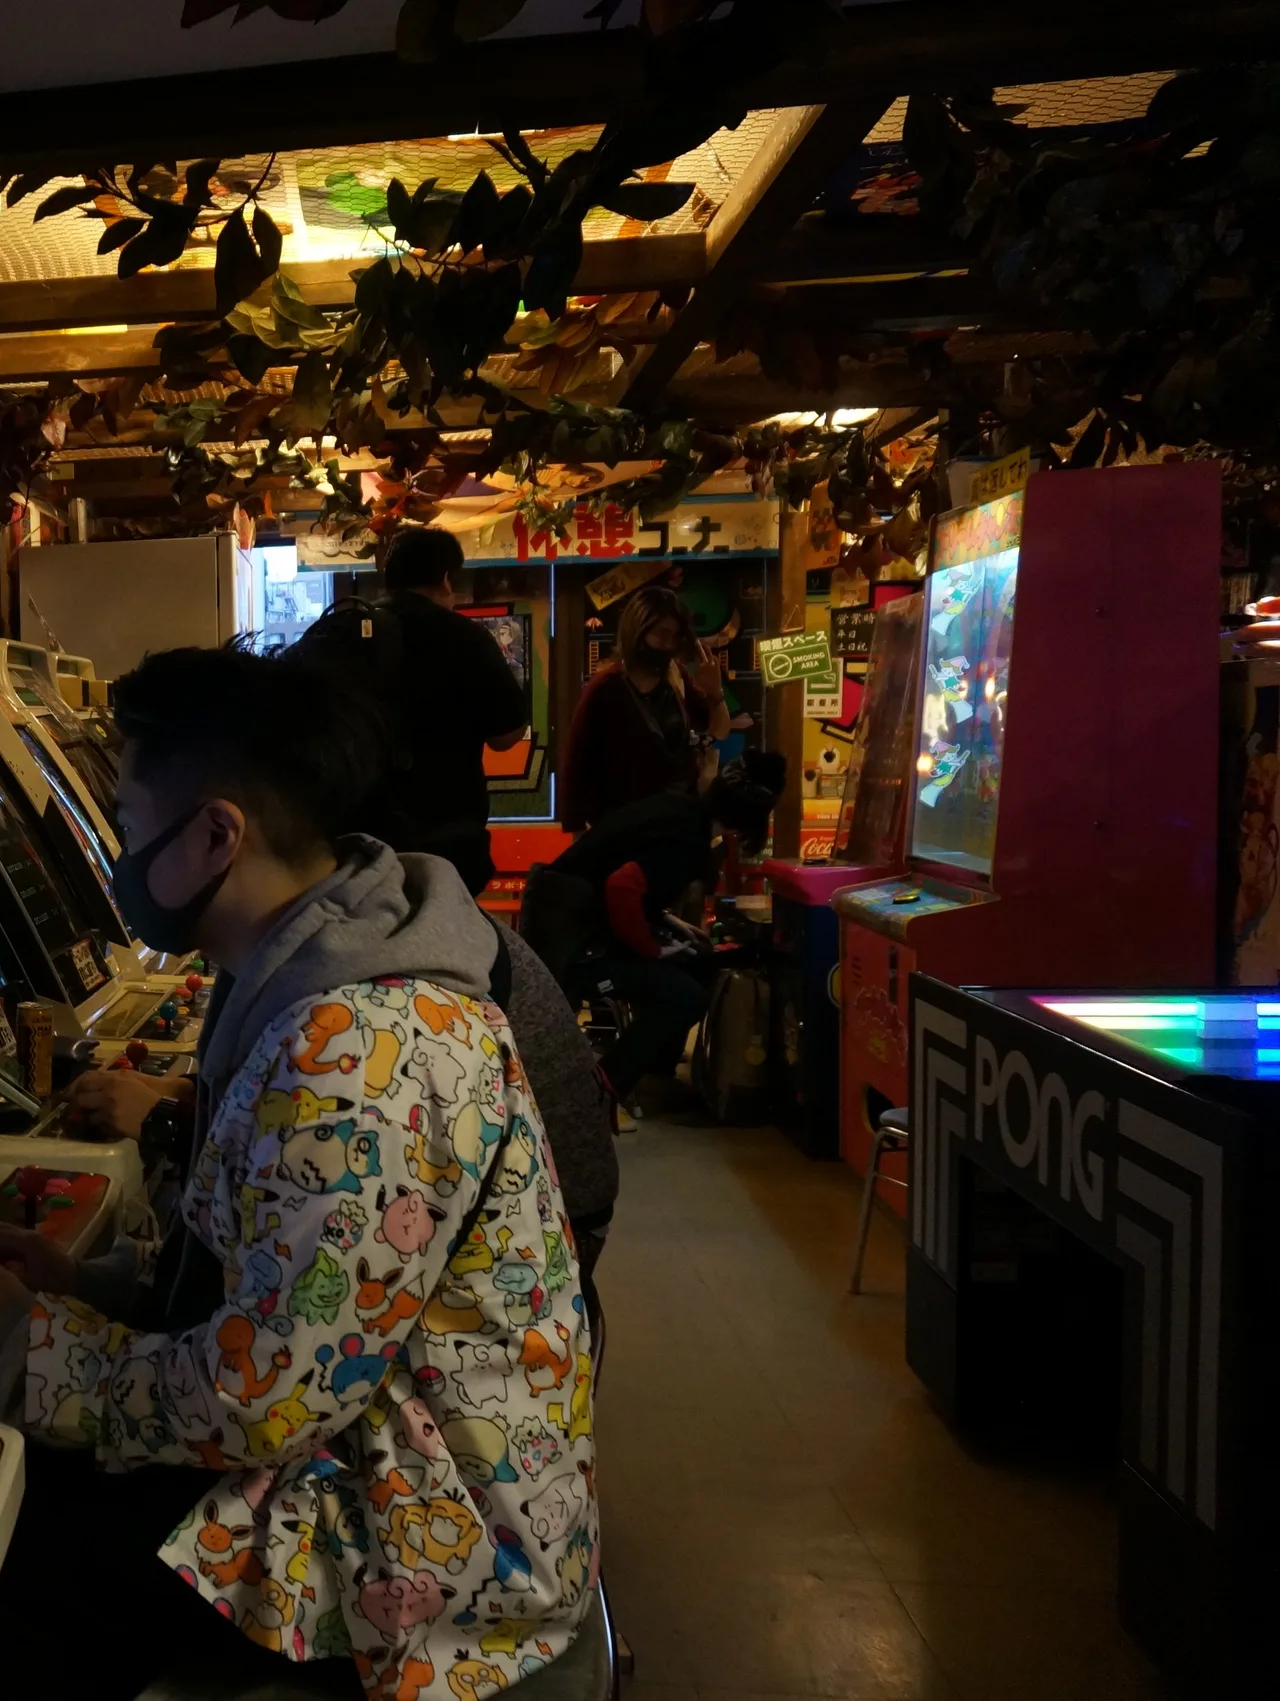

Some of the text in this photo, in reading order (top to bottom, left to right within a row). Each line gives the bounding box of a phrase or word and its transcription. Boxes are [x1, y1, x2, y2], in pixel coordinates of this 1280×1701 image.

[792, 652, 825, 664] SMOKING
[801, 661, 820, 670] AREA
[974, 1034, 1106, 1222] PONG
